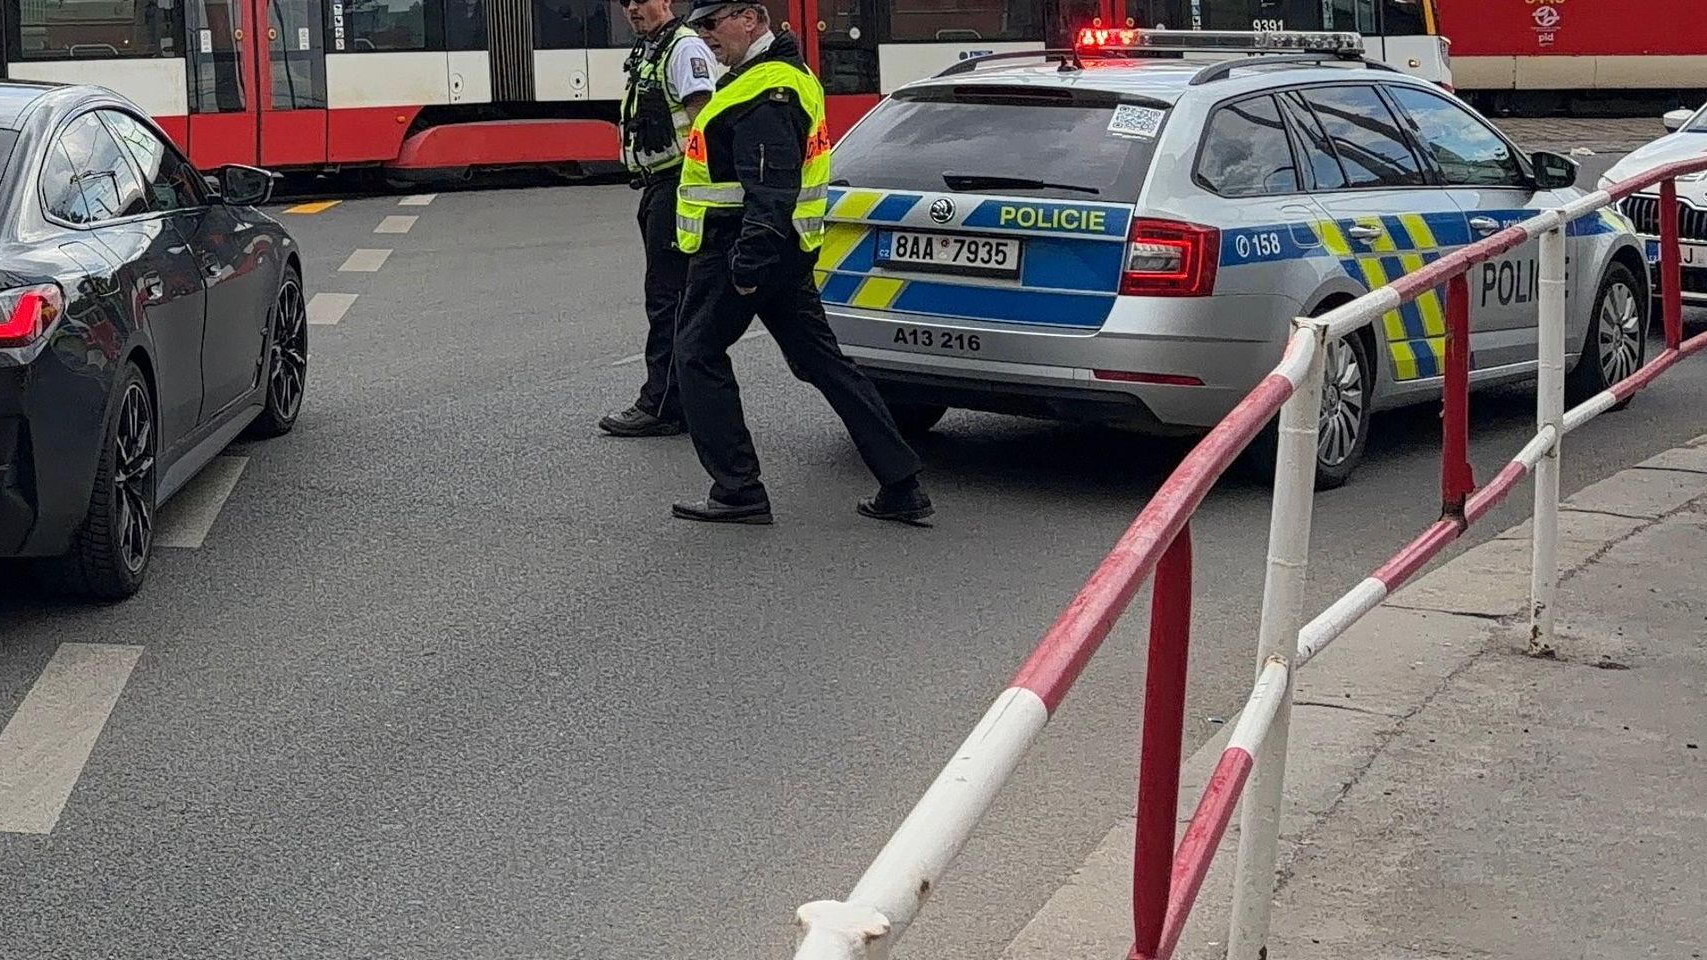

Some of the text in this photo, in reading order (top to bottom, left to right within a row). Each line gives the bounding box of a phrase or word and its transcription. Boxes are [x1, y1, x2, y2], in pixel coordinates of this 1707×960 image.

[1253, 19, 1284, 32] 9391
[1000, 205, 1106, 231] POLICIE
[895, 234, 1009, 266] 8AA 7935
[1252, 232, 1281, 256] 158
[894, 327, 981, 352] A13 216
